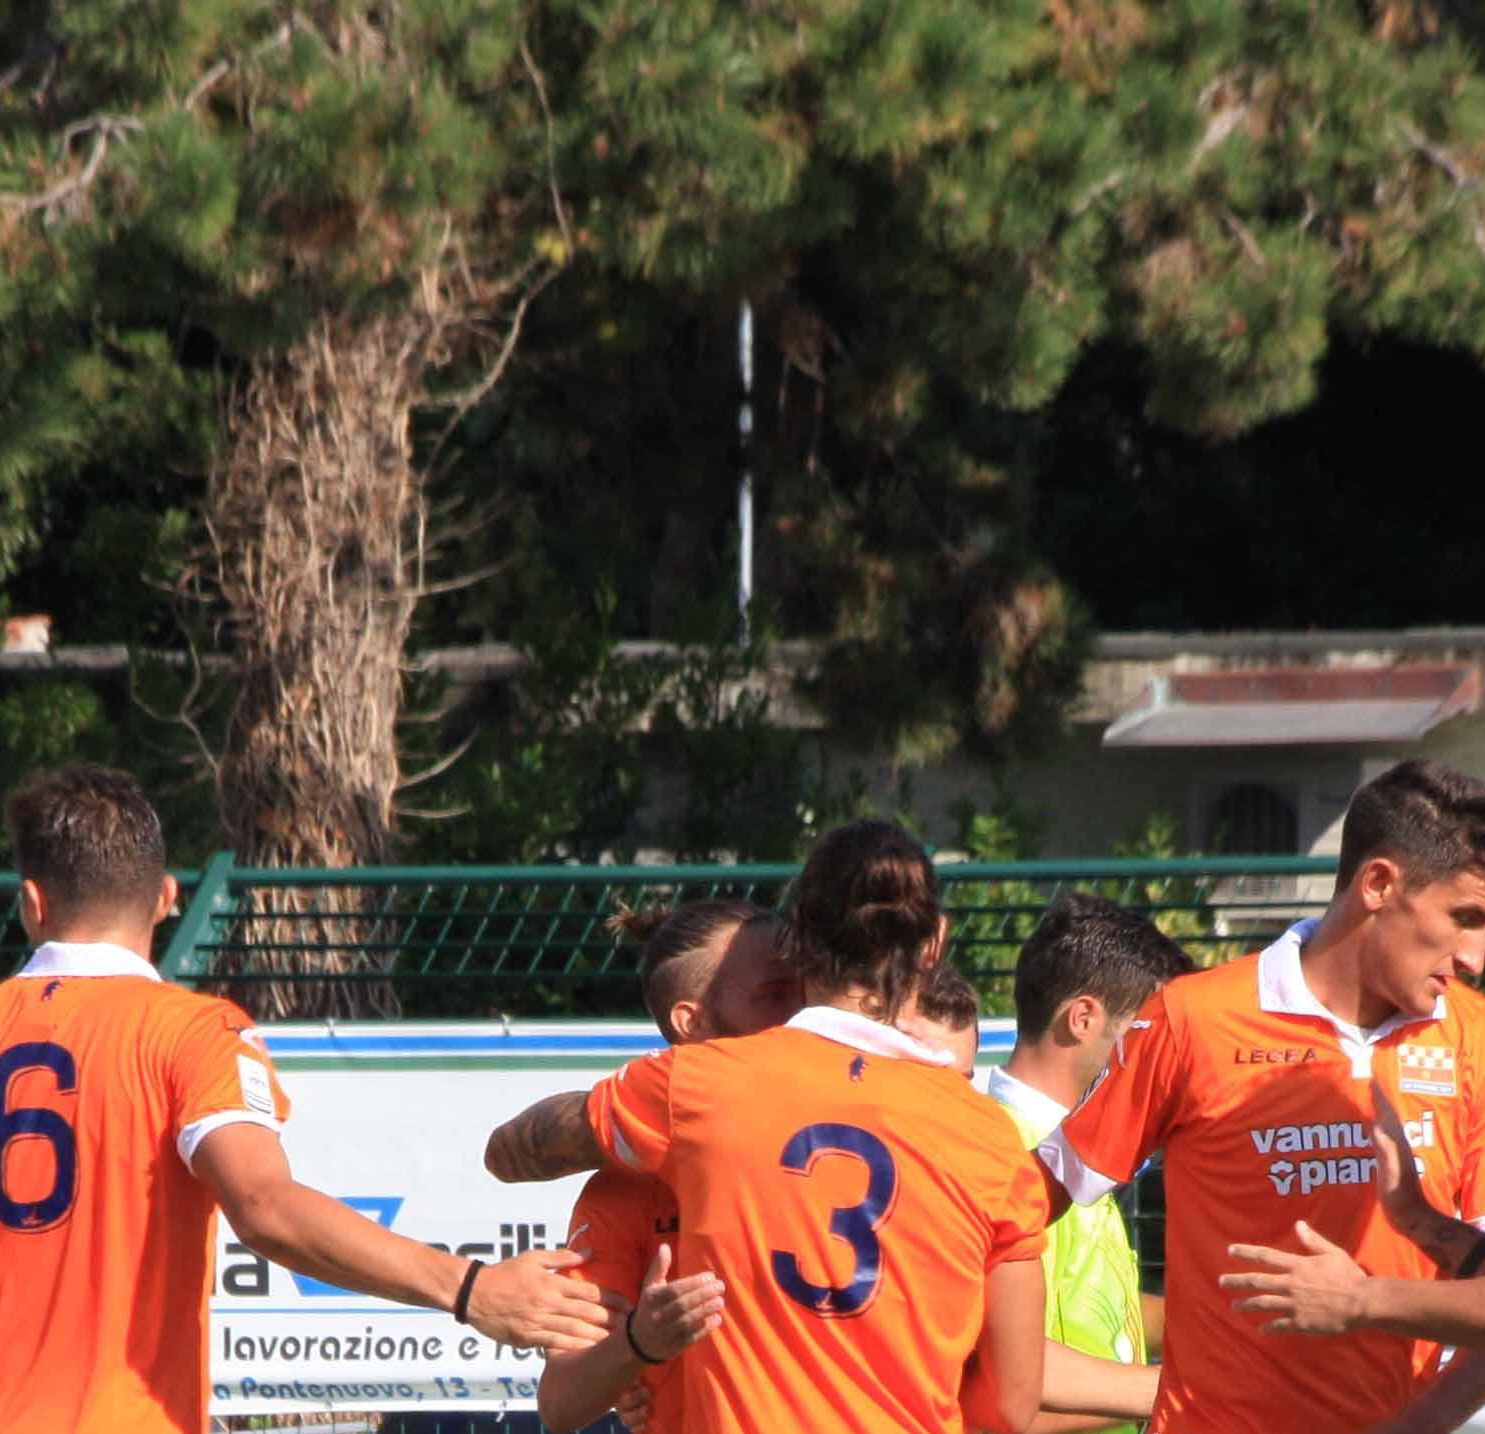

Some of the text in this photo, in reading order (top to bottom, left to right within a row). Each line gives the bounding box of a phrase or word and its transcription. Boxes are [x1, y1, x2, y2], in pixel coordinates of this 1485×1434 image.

[1233, 1046, 1318, 1066] LEGEA
[771, 1121, 902, 1319] 3
[222, 1325, 444, 1361] lavorazione
[457, 1336, 481, 1361] e
[240, 1376, 425, 1401] Pontenuovo,
[433, 1376, 471, 1398] 13
